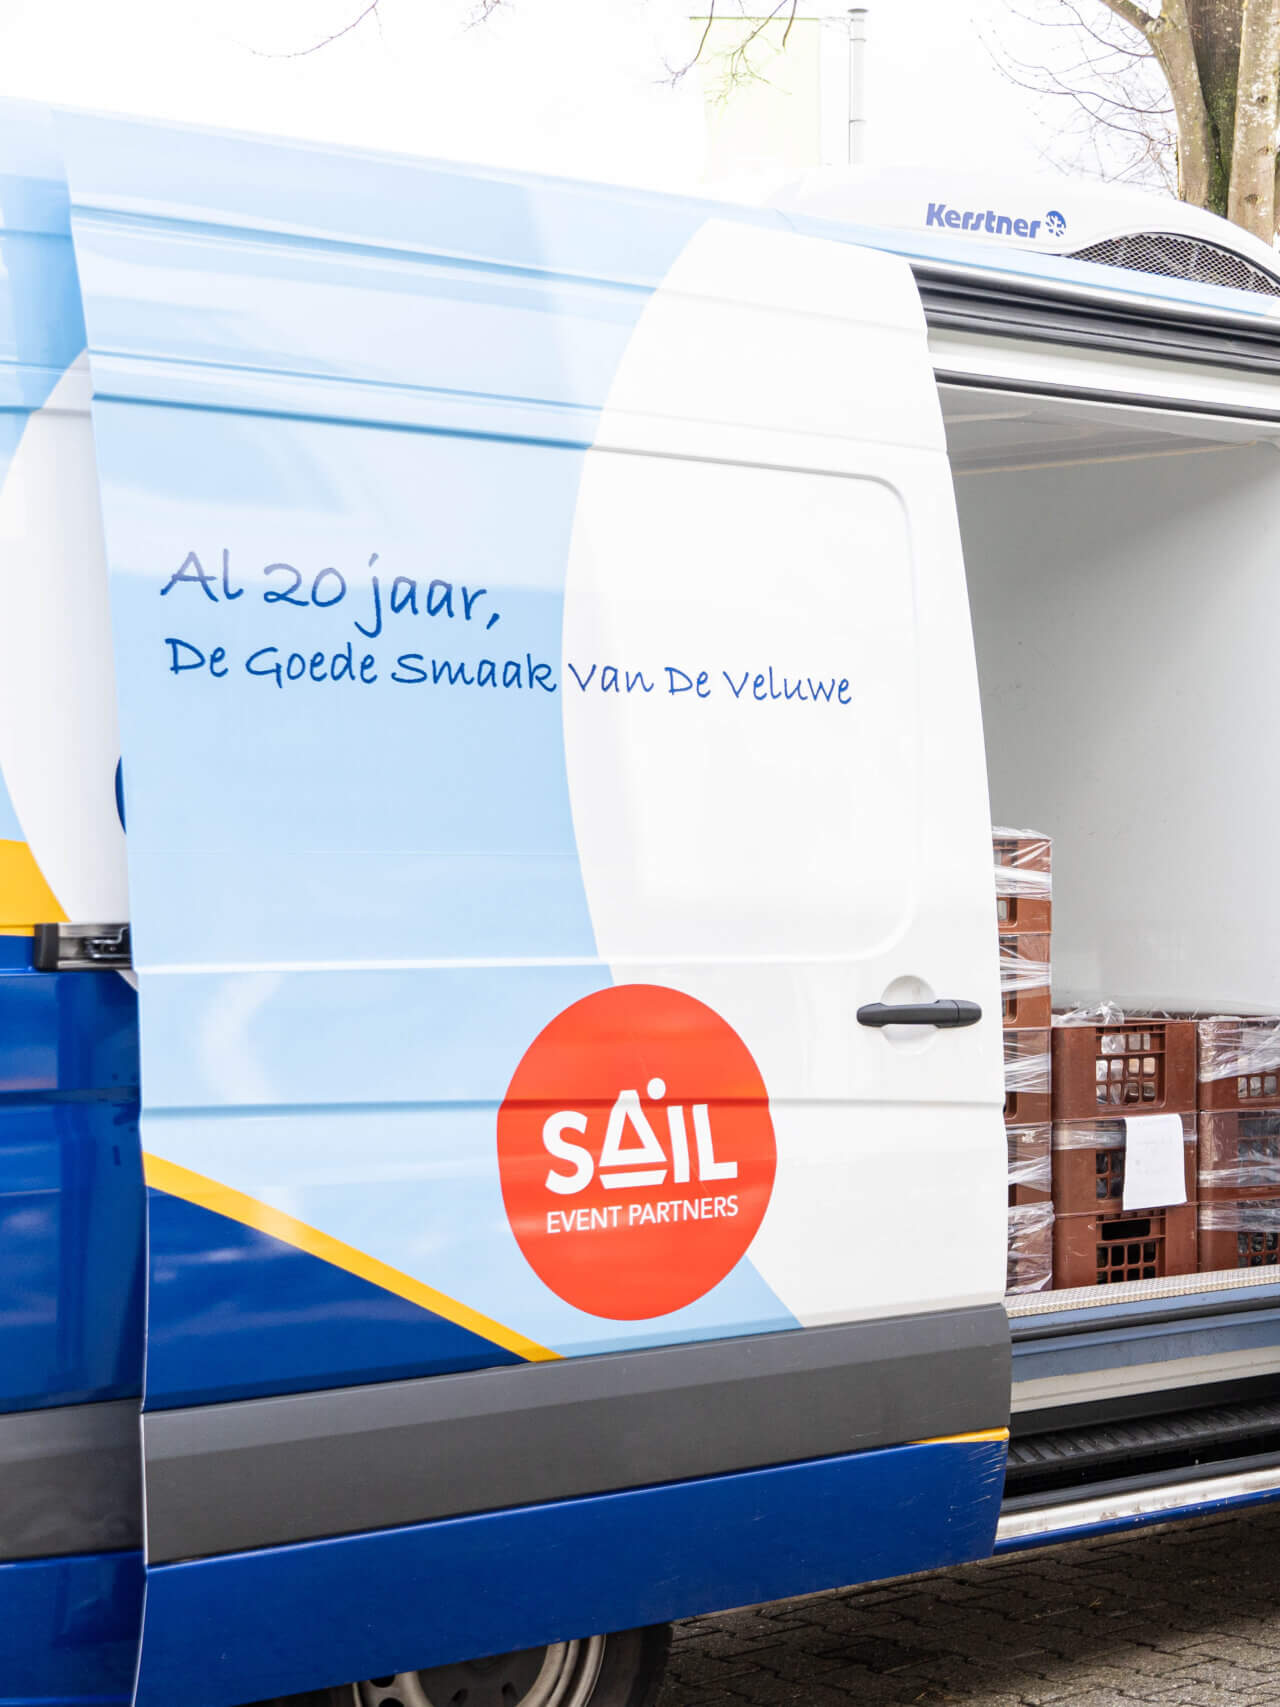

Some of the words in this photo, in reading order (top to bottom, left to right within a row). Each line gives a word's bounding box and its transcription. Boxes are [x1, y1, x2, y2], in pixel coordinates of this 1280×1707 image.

[926, 202, 1042, 239] Kerstner
[160, 547, 244, 603] Al
[263, 562, 349, 608] 20
[354, 552, 501, 638] jaar,
[164, 636, 229, 678] De
[246, 641, 378, 689] Goede
[391, 652, 558, 693] Smaak
[664, 665, 712, 699] De
[542, 1077, 739, 1196] SAIL
[546, 1204, 623, 1235] EVENT
[628, 1194, 740, 1227] PARTNERS
